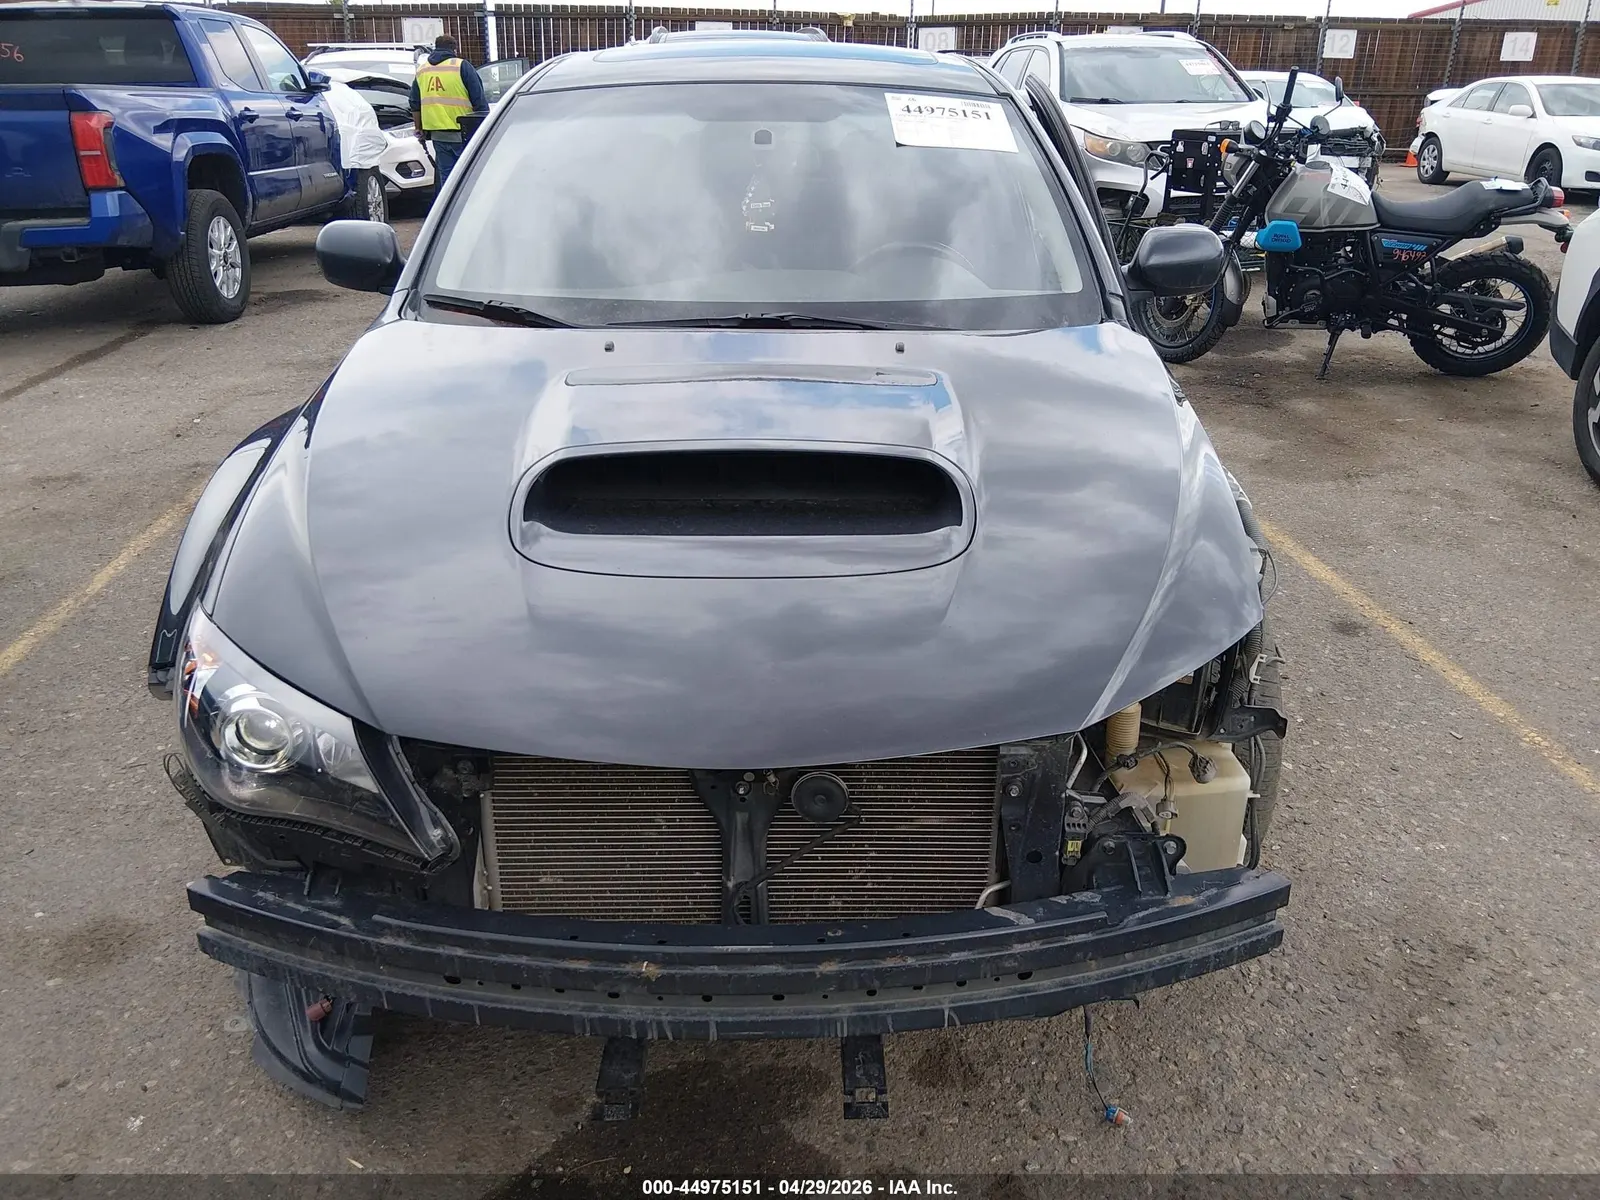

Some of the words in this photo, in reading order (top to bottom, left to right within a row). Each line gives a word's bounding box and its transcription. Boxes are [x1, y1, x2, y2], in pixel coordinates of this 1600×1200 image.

[411, 23, 435, 42] 04
[924, 32, 949, 50] 08
[1, 43, 24, 62] 56
[1328, 34, 1351, 53] 12
[1509, 36, 1532, 56] 14
[901, 104, 991, 120] 44975151
